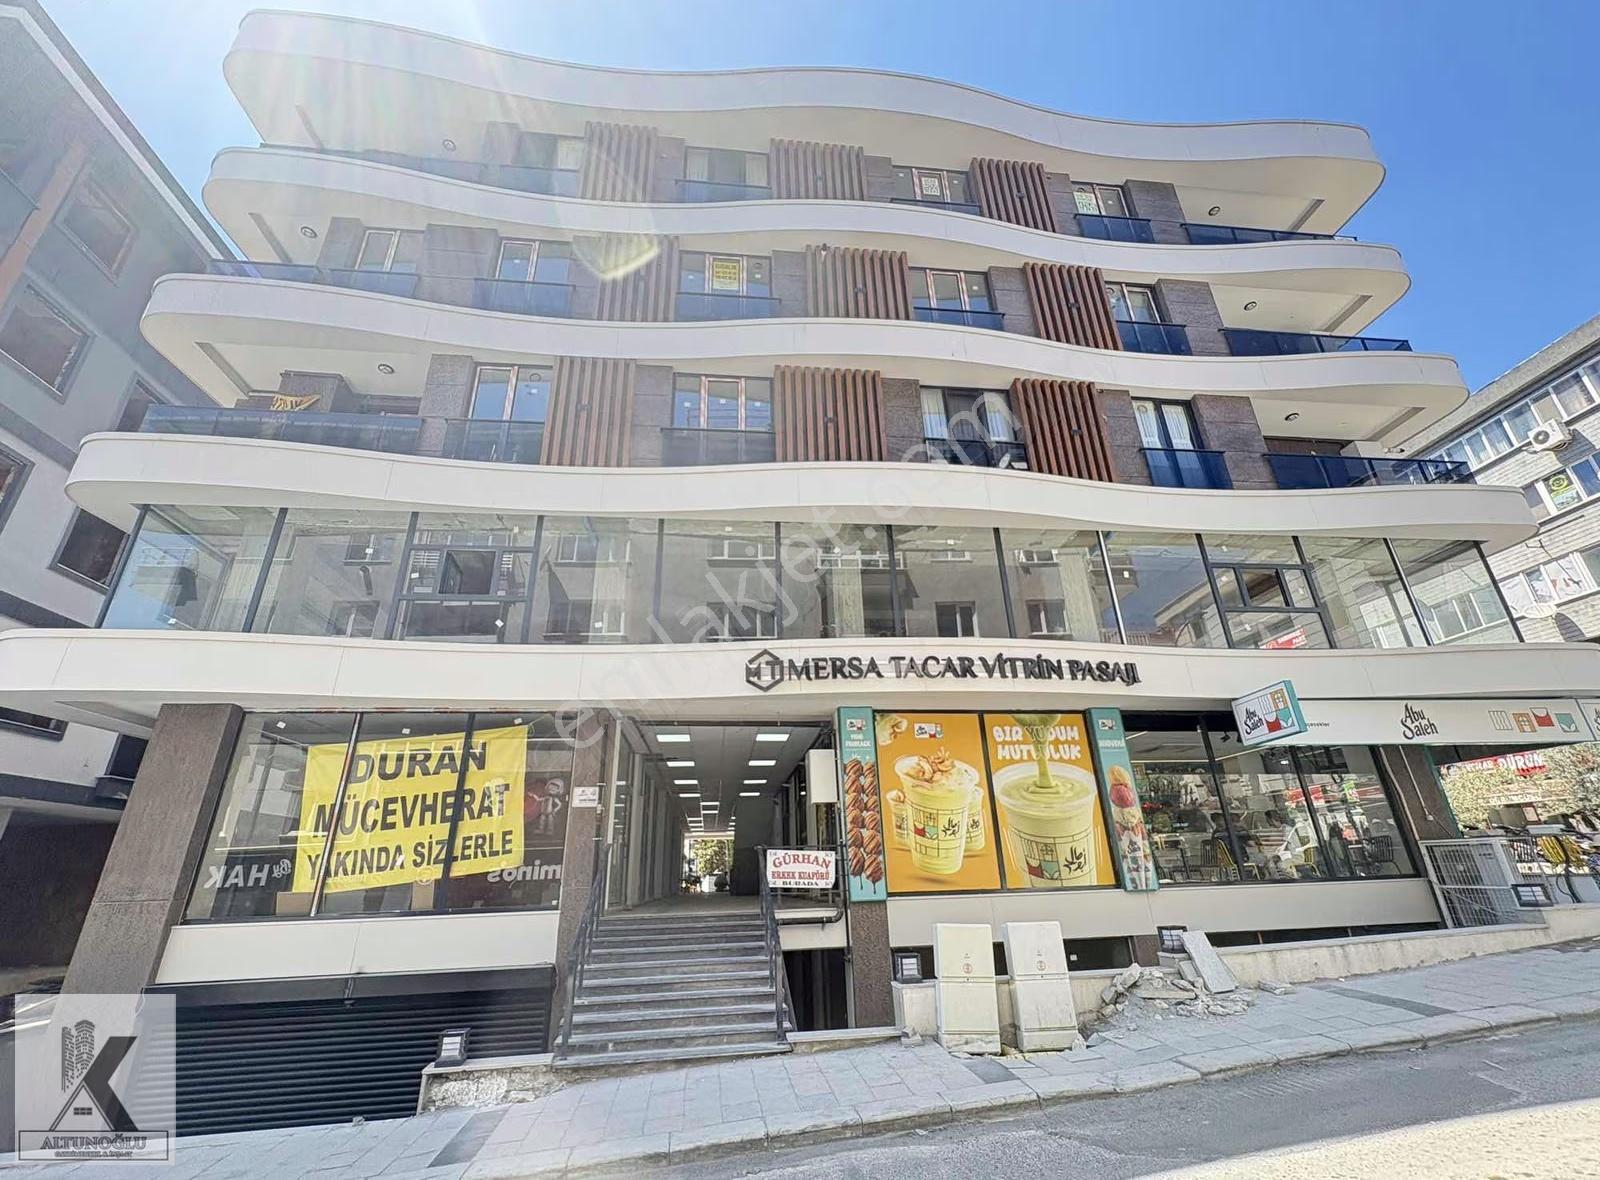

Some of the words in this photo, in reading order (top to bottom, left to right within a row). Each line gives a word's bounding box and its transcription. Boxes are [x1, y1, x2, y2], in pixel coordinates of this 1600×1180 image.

[788, 657, 884, 681] MERSA
[888, 655, 977, 679] TACAR
[979, 652, 1064, 681] VİTRİN
[1066, 659, 1142, 687] PASAJI
[1400, 717, 1439, 740] Saleh
[1404, 702, 1427, 725] Abu
[348, 741, 487, 785] DURAN
[313, 783, 510, 838] MÜCEVHERAT
[412, 830, 513, 868] SİZERLE
[772, 852, 831, 870] GÜRHAN
